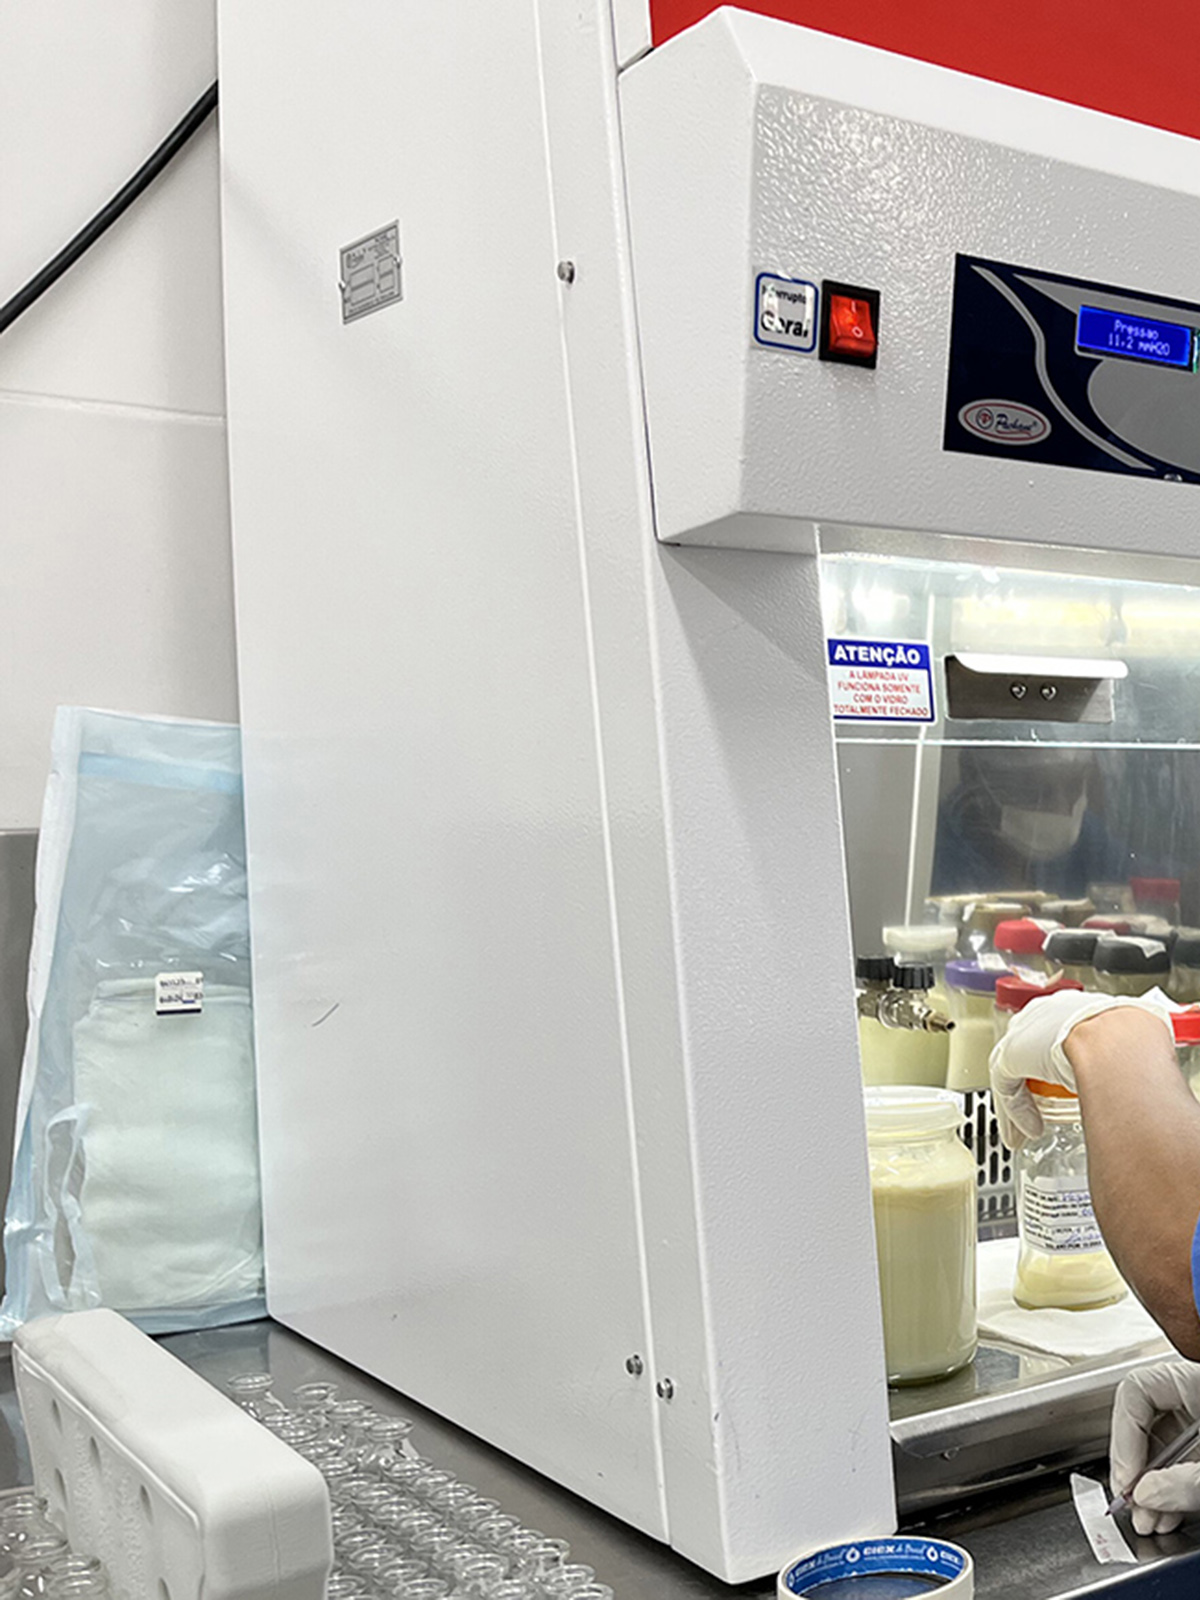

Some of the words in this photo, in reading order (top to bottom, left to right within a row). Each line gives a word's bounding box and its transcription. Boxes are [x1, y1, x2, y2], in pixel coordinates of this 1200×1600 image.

[834, 645, 921, 667] ATENÇÃO
[837, 681, 881, 692] FUNCIONA
[882, 683, 921, 694] SOMENTE
[853, 693, 872, 703] COM
[874, 694, 882, 704] O
[883, 694, 909, 705] VIDRO
[833, 704, 888, 716] TOTALMENTE
[890, 706, 929, 717] FECHADO
